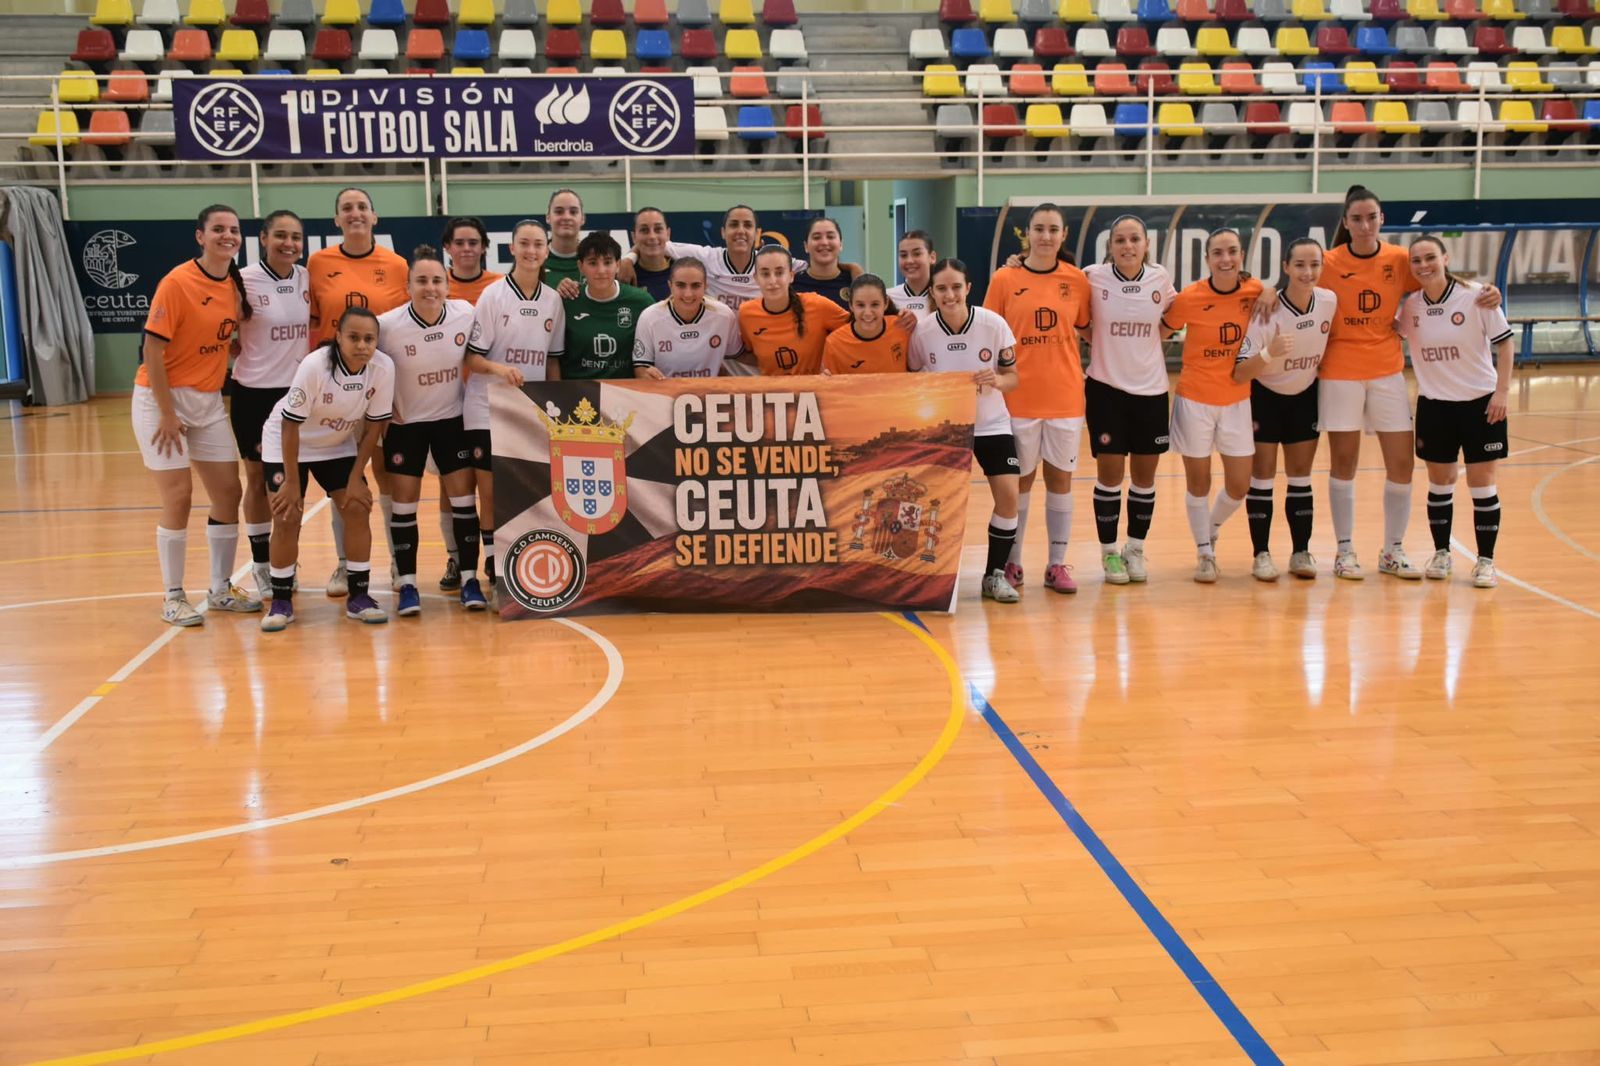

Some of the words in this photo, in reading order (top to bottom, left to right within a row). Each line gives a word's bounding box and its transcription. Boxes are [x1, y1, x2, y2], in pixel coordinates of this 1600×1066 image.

[322, 82, 513, 106] DIVISIÓN
[322, 105, 435, 154] FÚTBOL
[444, 110, 518, 153] SALA
[534, 139, 594, 153] Iberdrola
[84, 292, 149, 309] ceuta
[258, 295, 269, 307] 13
[1102, 288, 1109, 301] 9
[502, 314, 510, 327] 7
[270, 323, 308, 342] CEUTA
[1110, 322, 1152, 338] CEUTA
[404, 345, 417, 357] 19
[658, 340, 673, 352] 20
[1420, 346, 1461, 362] CEUTA
[504, 347, 546, 367] CEUTA
[1283, 357, 1321, 372] CEUTA
[417, 366, 459, 387] CEUTA
[322, 393, 334, 405] 18
[674, 392, 826, 444] CEUTA
[675, 447, 710, 476] NO
[716, 446, 747, 476] SE
[752, 445, 840, 477] VENDE,
[676, 478, 828, 532] CEUTA
[528, 532, 574, 554] CAMOENS
[675, 534, 708, 566] SE
[714, 532, 838, 565] DEFIENDE
[529, 597, 563, 607] CEUTA
